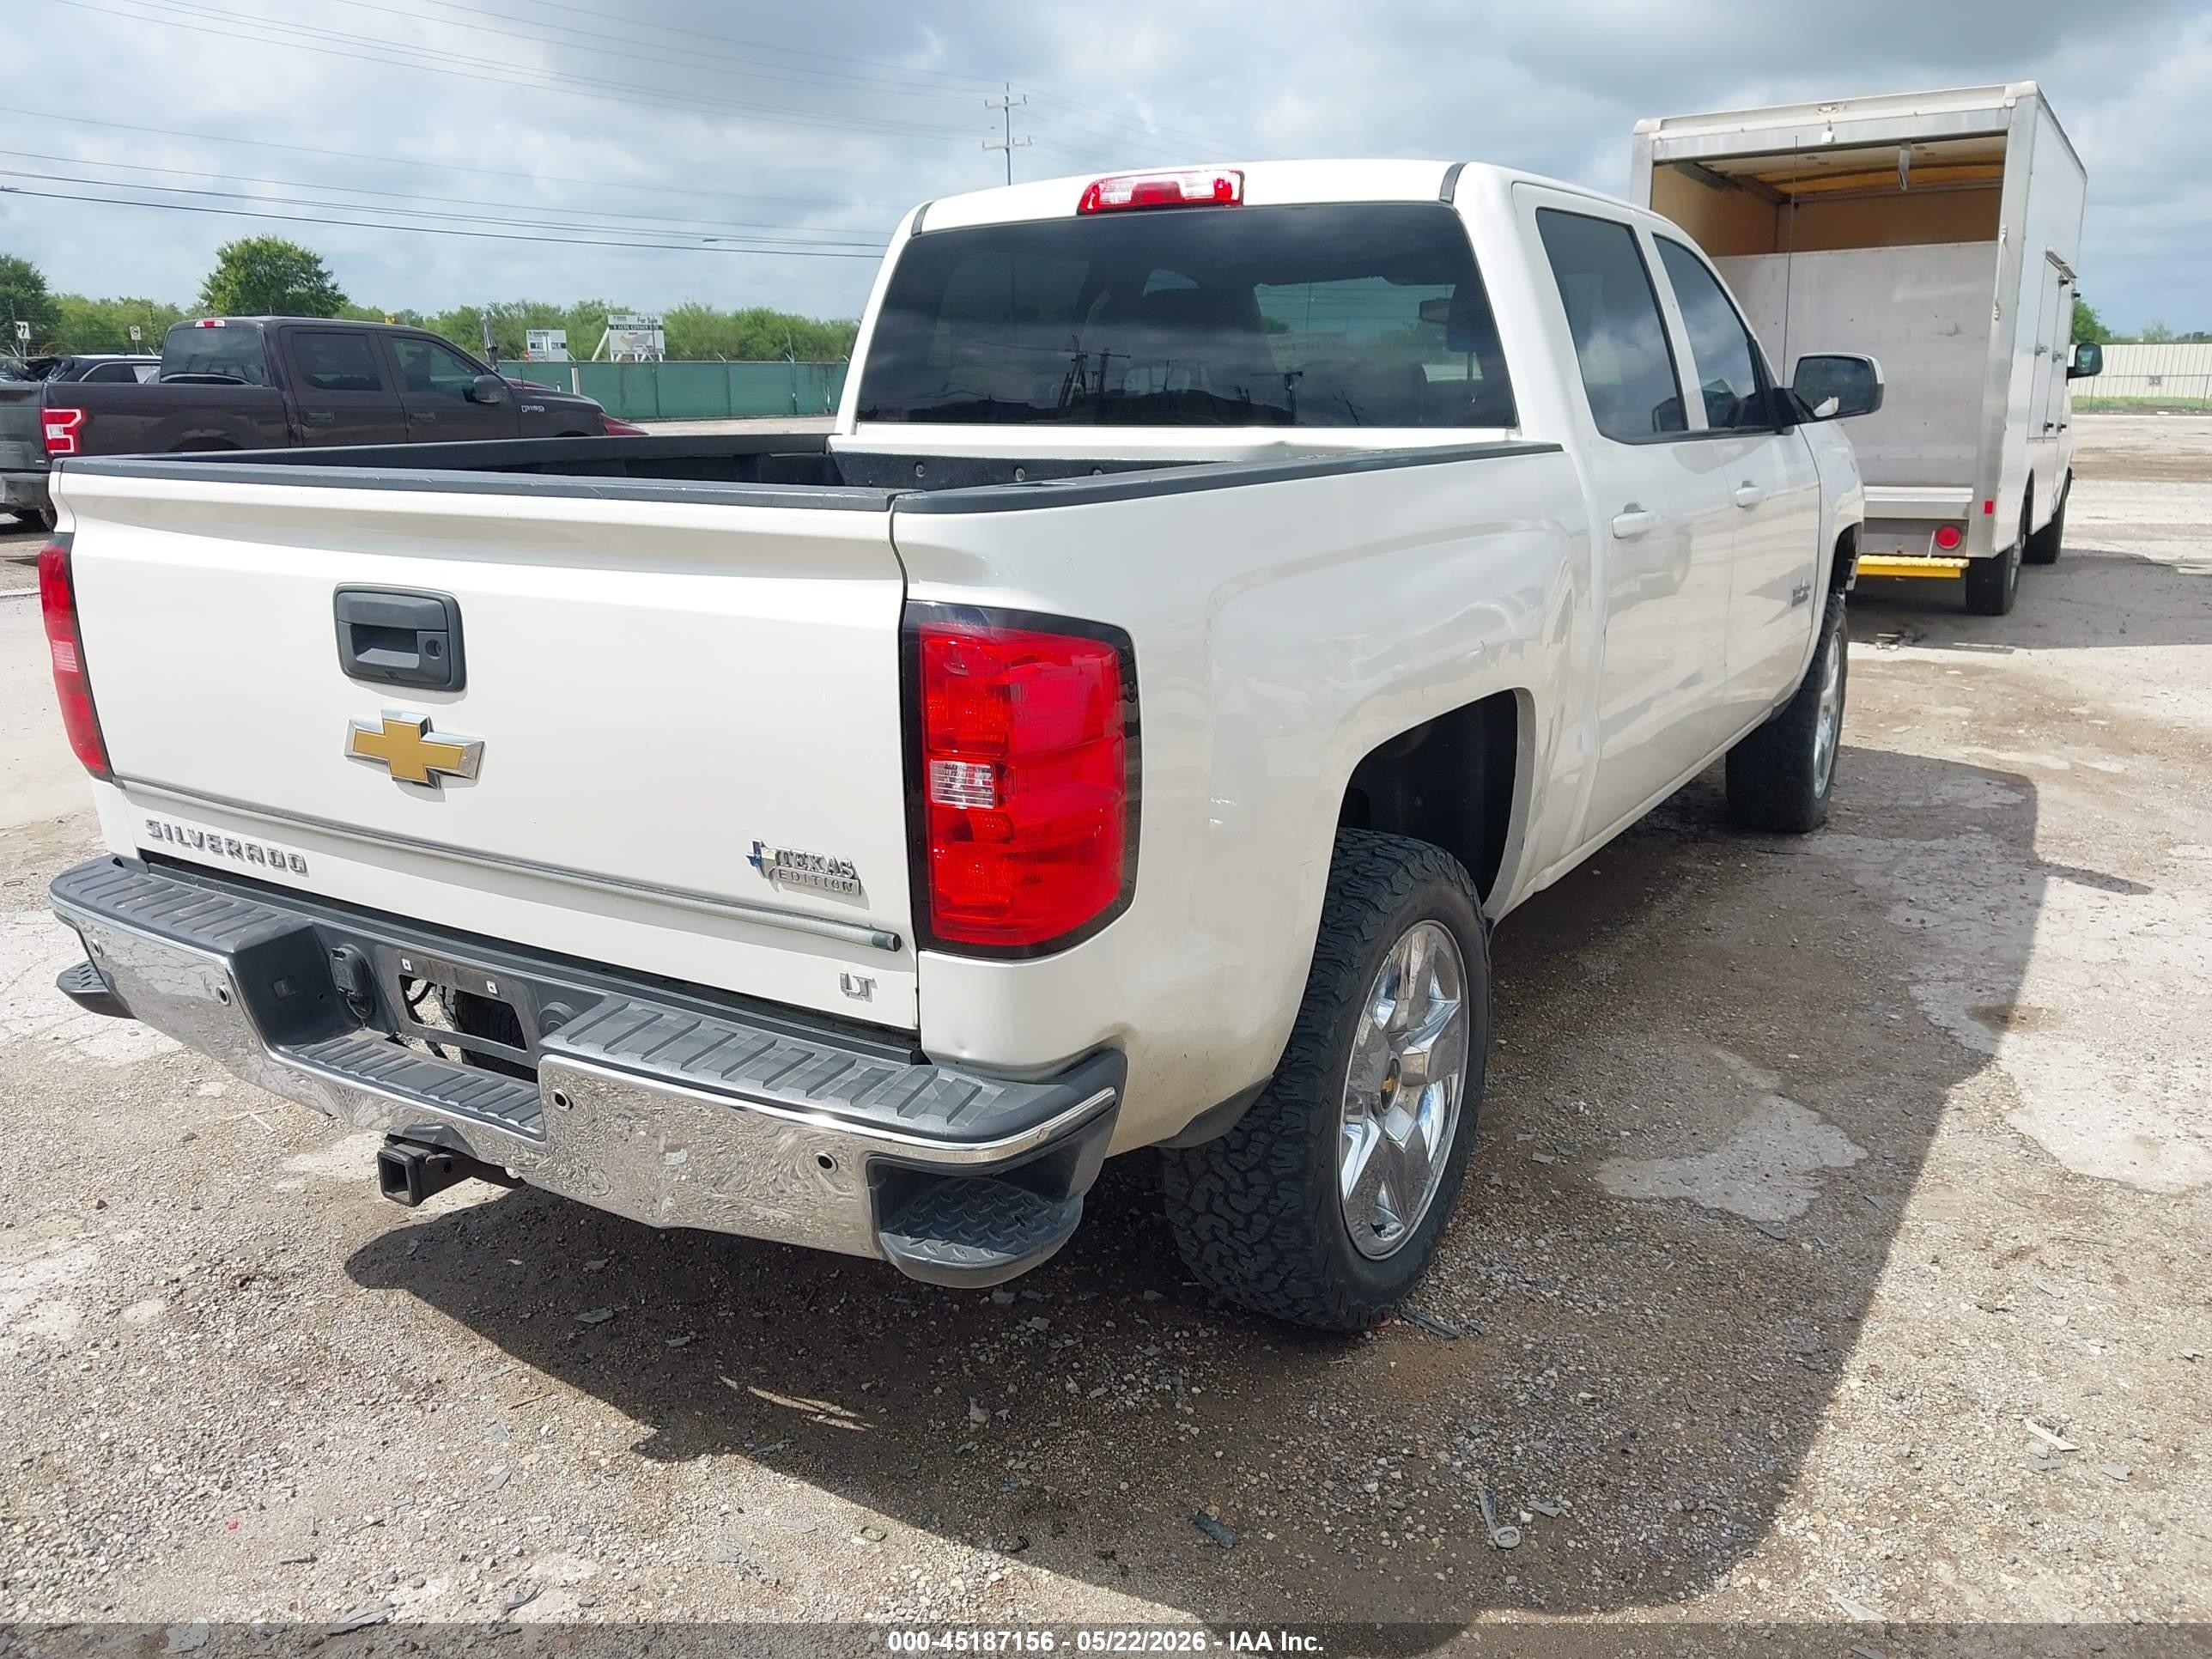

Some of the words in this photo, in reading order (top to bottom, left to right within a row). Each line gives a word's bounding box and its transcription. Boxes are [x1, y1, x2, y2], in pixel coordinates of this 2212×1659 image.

[2148, 376, 2161, 386] 33
[145, 819, 309, 875] SILVERADO
[776, 848, 858, 879] TEXAS
[778, 868, 854, 892] EDITION
[840, 971, 877, 1002] LT
